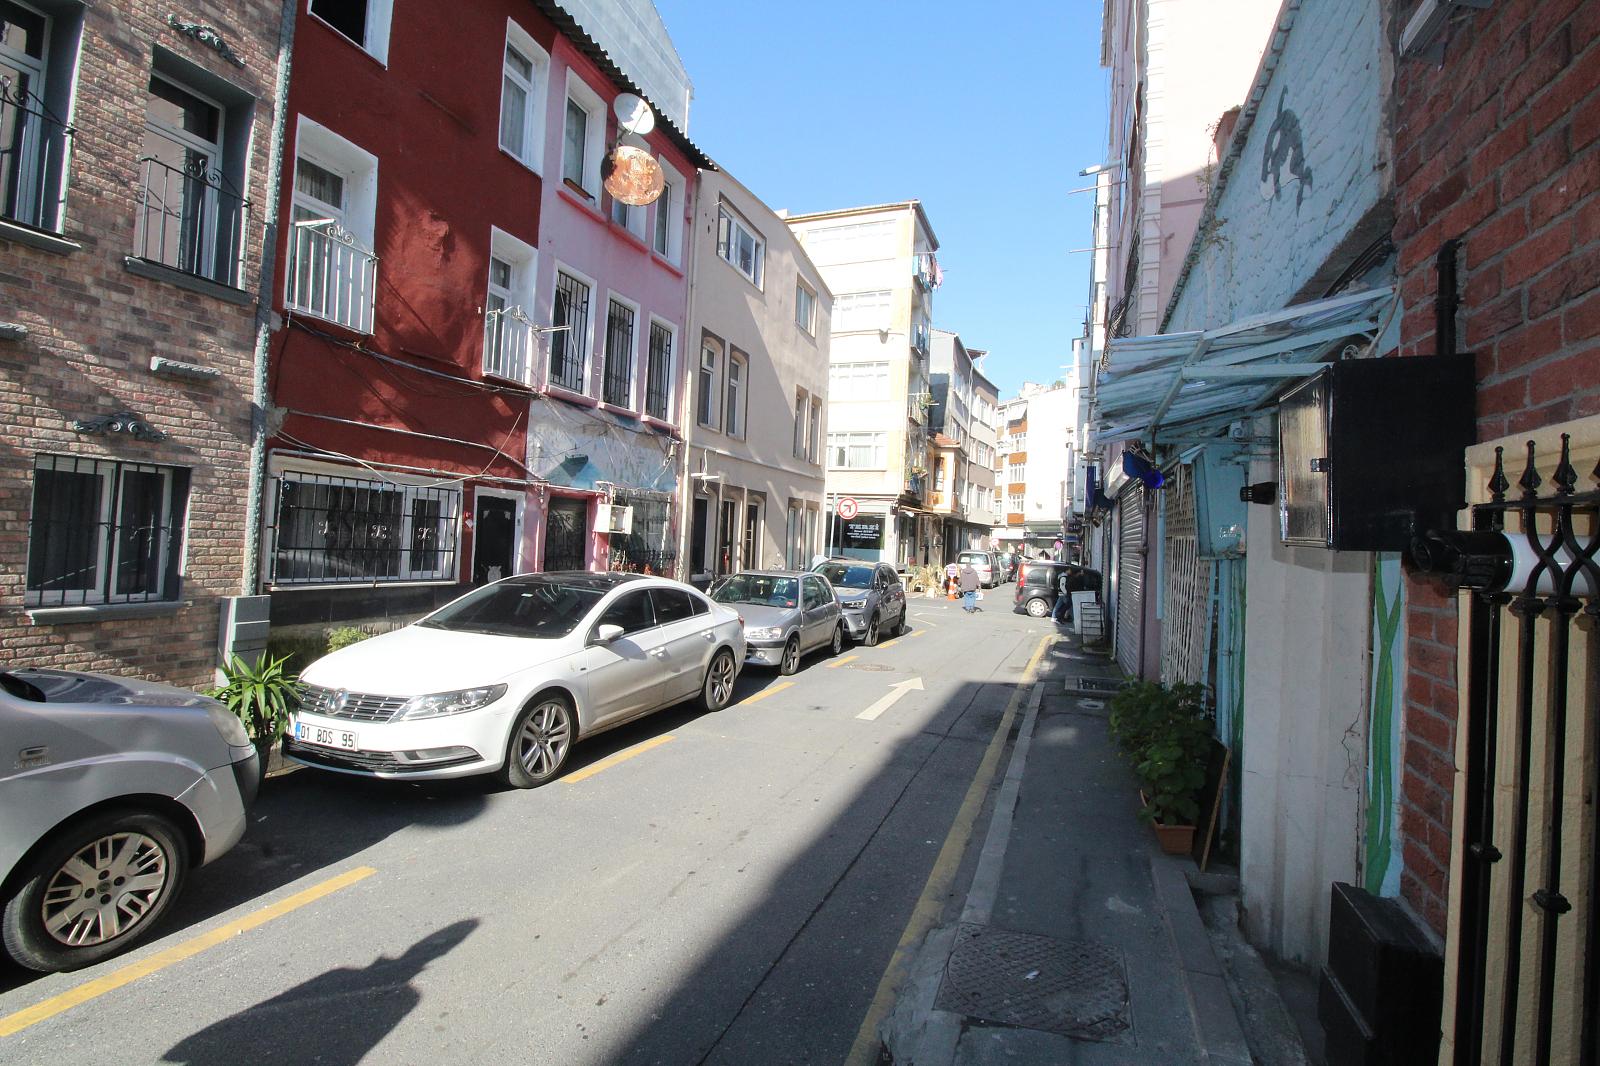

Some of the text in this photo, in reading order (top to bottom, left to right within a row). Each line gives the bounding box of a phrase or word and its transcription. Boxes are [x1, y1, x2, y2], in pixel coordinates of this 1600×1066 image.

[301, 725, 353, 748] 01 BDS 95
